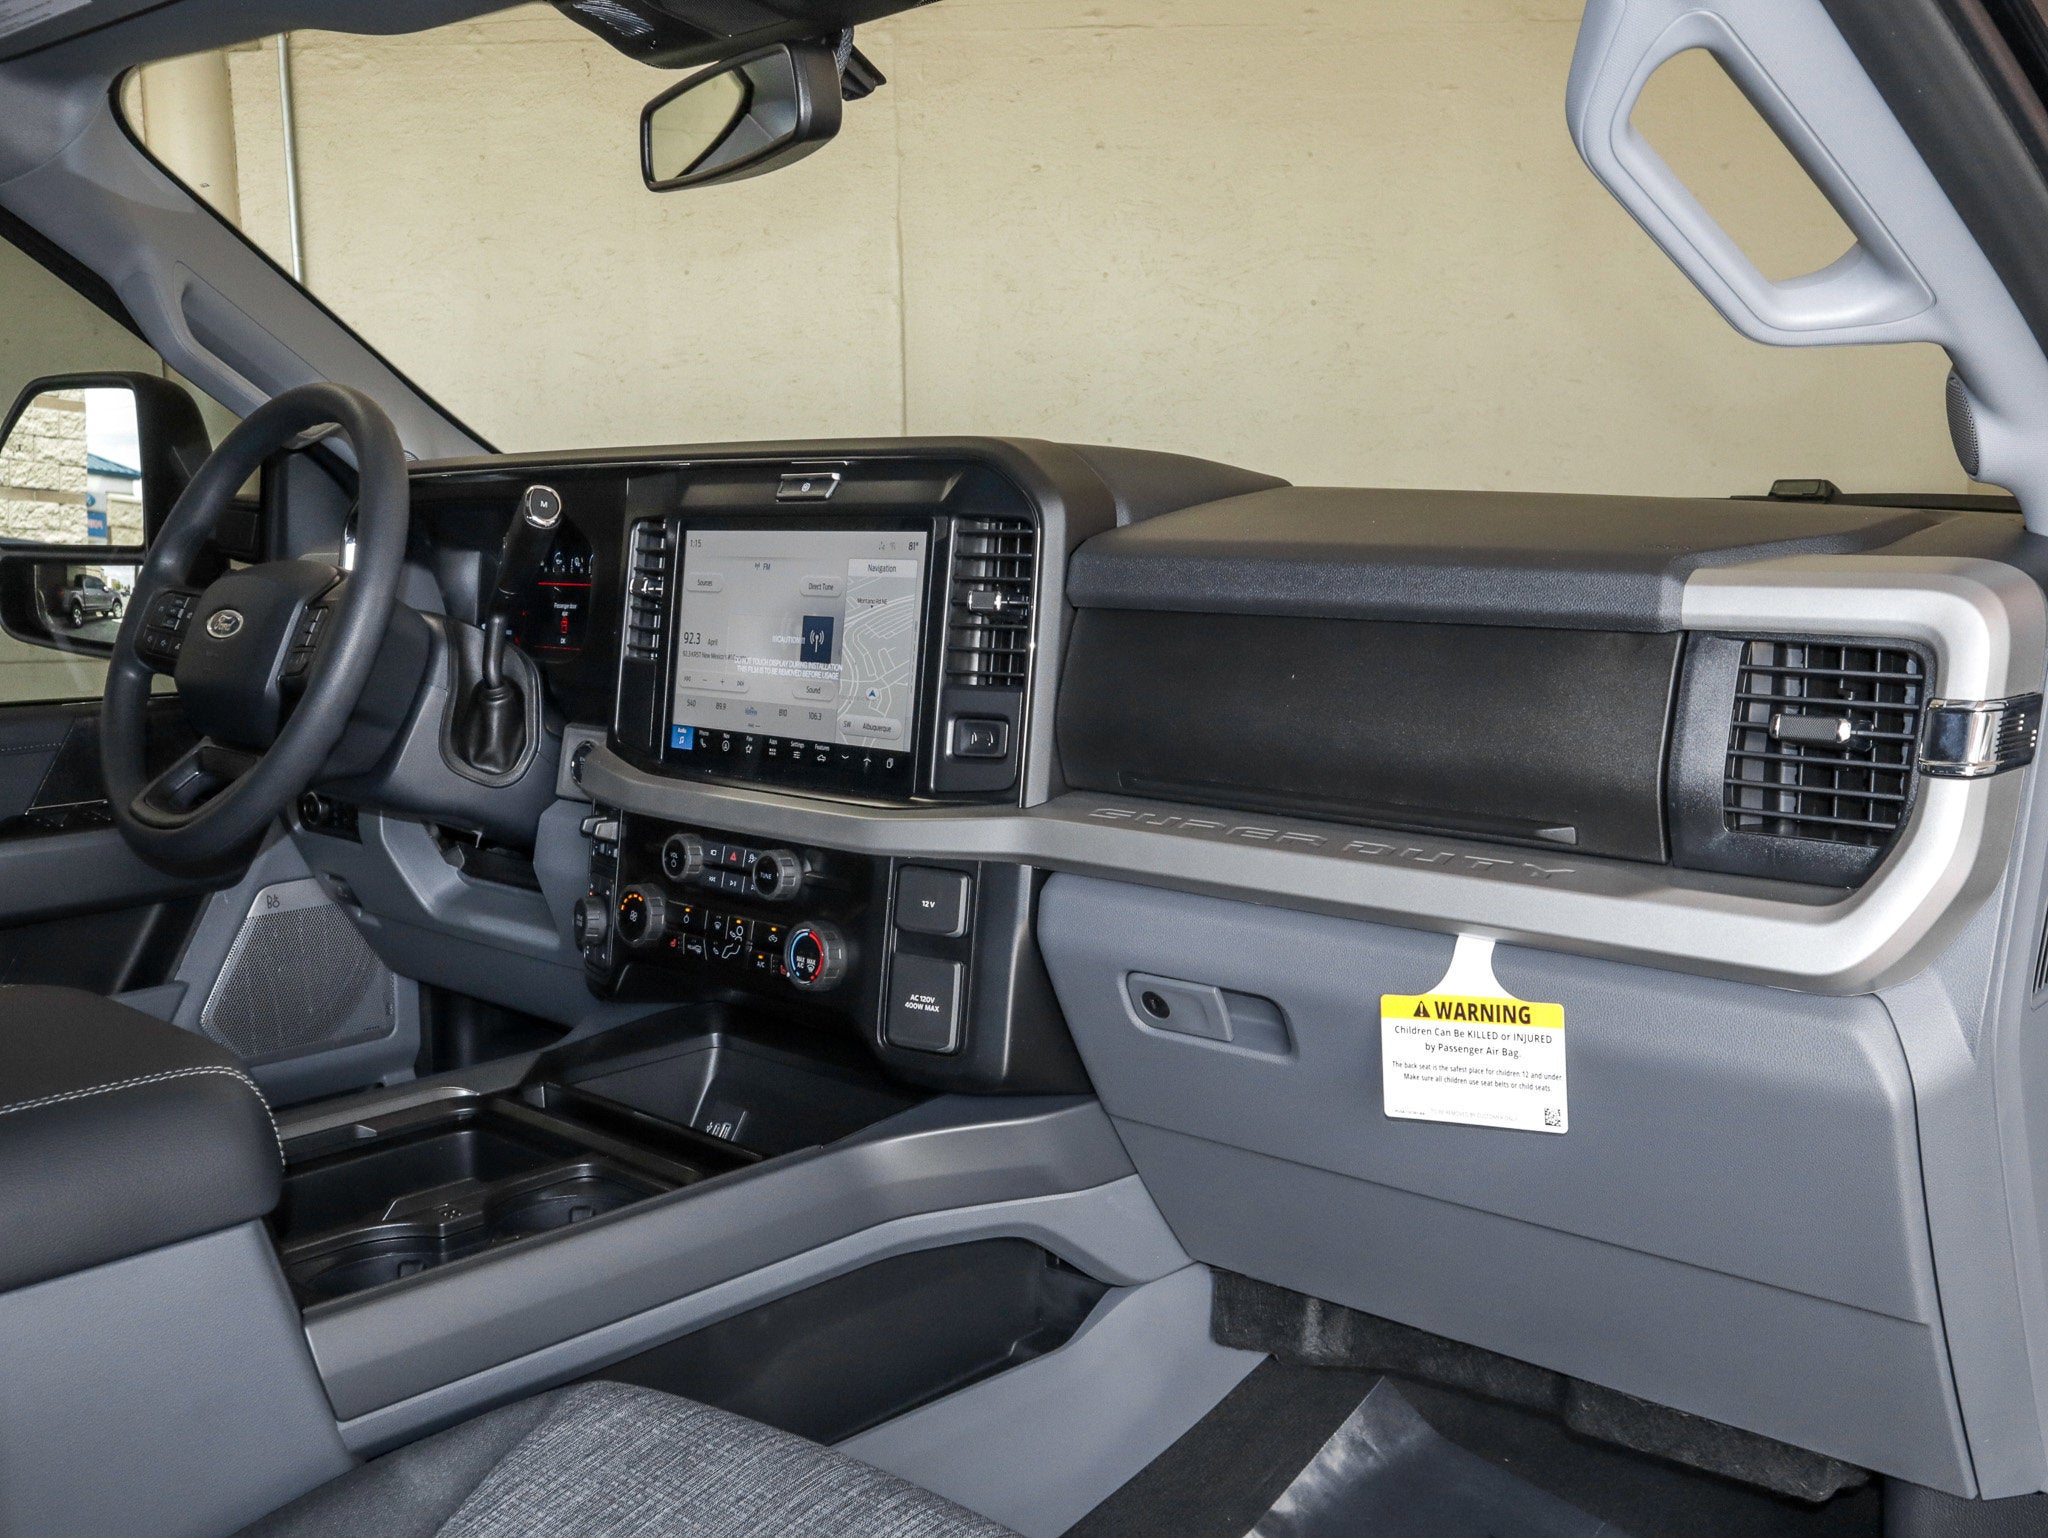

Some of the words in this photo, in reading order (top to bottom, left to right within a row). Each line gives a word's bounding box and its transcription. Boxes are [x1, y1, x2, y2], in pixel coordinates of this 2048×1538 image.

[690, 540, 702, 548] 1:15
[868, 564, 896, 573] Navigation
[683, 632, 701, 645] 92.3
[708, 638, 718, 646] April
[769, 659, 789, 668] DISPLAY
[789, 660, 808, 670] DURING
[809, 662, 843, 671] INSTALLATION
[778, 668, 802, 677] REMOVED
[802, 670, 822, 678] BEFORE
[822, 671, 839, 680] USAGE
[806, 686, 821, 694] Sound
[808, 712, 822, 720] 106.3
[862, 723, 892, 732] Albuquerque
[1088, 807, 1328, 847] SUPER
[1341, 839, 1576, 880] DUTY
[925, 1004, 940, 1012] MAX
[1435, 1001, 1531, 1024] WARNING
[1394, 1026, 1432, 1036] Children
[1435, 1028, 1451, 1037] Can
[1454, 1029, 1465, 1038] Be
[1468, 1030, 1498, 1040] KILLED
[1514, 1033, 1552, 1044] INJURED
[1425, 1042, 1436, 1052] by
[1438, 1043, 1483, 1056] Passenger
[1486, 1047, 1499, 1055] Air
[1502, 1048, 1521, 1059] Bag.
[1450, 1065, 1467, 1073] safest
[1469, 1067, 1484, 1075] place
[1496, 1068, 1520, 1077] children
[1444, 1076, 1467, 1085] children
[1519, 1082, 1533, 1090] child
